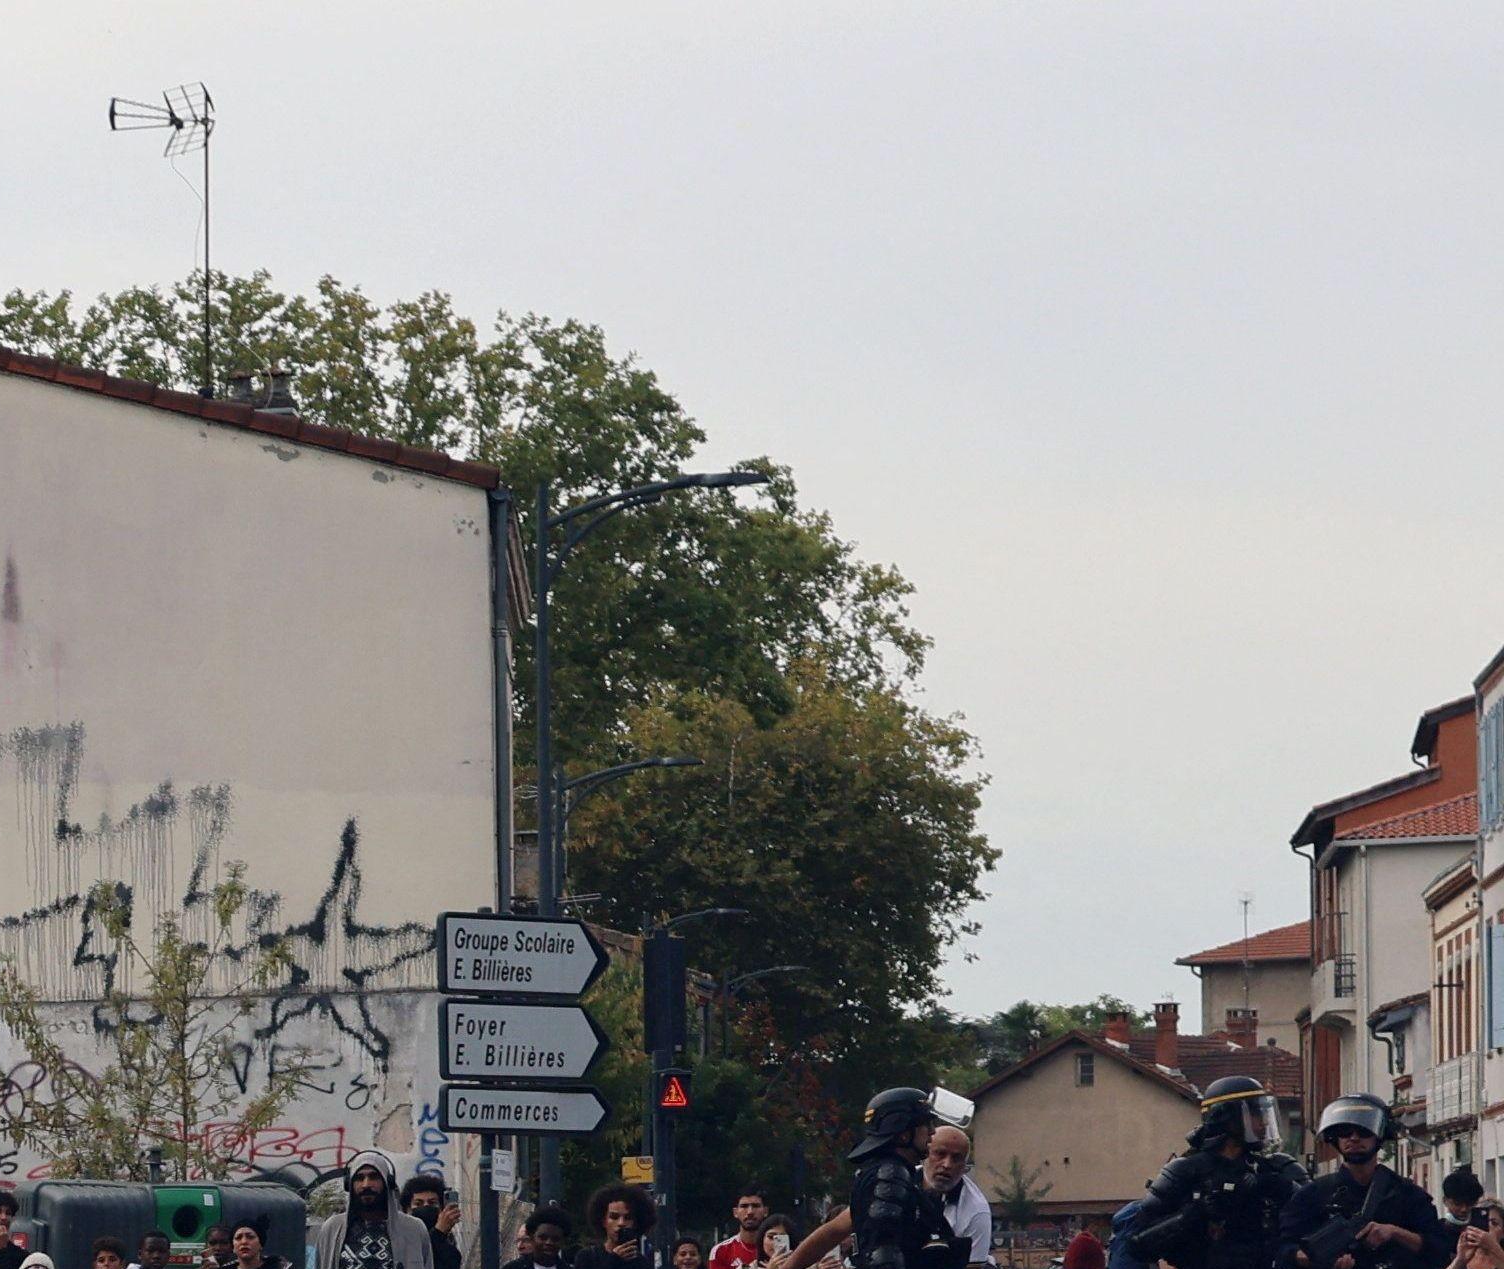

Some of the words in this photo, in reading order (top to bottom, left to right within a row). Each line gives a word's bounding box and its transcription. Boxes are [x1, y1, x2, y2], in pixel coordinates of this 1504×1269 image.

[454, 928, 509, 956] Groupe
[514, 930, 575, 955] Scolaire
[454, 958, 467, 980] E.
[472, 959, 532, 982] Billières
[455, 1013, 506, 1040] Foyer
[455, 1044, 470, 1066] E.
[485, 1044, 565, 1068] Billières
[455, 1097, 559, 1122] Commerces
